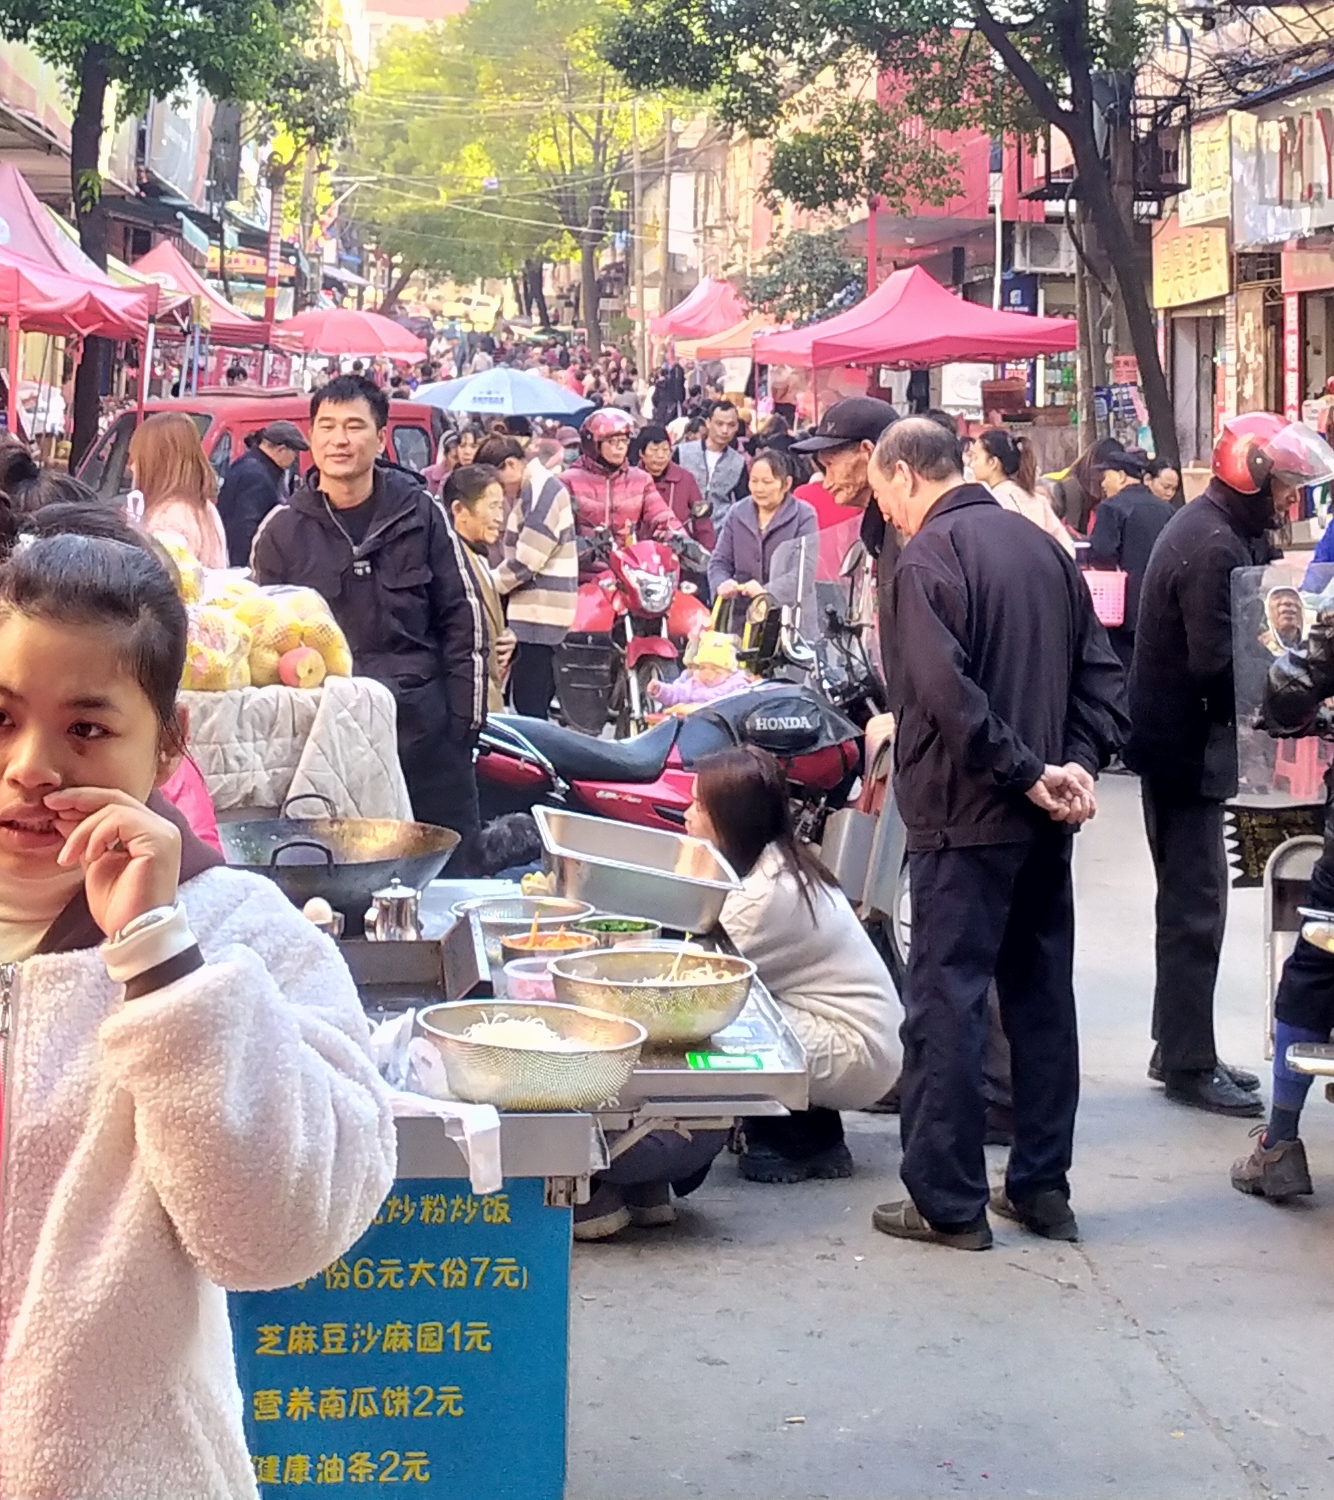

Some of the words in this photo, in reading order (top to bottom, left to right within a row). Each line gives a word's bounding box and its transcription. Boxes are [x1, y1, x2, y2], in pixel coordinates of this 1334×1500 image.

[754, 715, 813, 731] HONDA
[371, 1193, 512, 1226] 炒粉炒饭
[294, 1256, 529, 1291] 份6元大份7元)
[255, 1320, 493, 1356] 芝麻豆沙麻园1元
[252, 1384, 465, 1422] 营养南瓜饼2元
[251, 1450, 431, 1486] 健康油条2元
